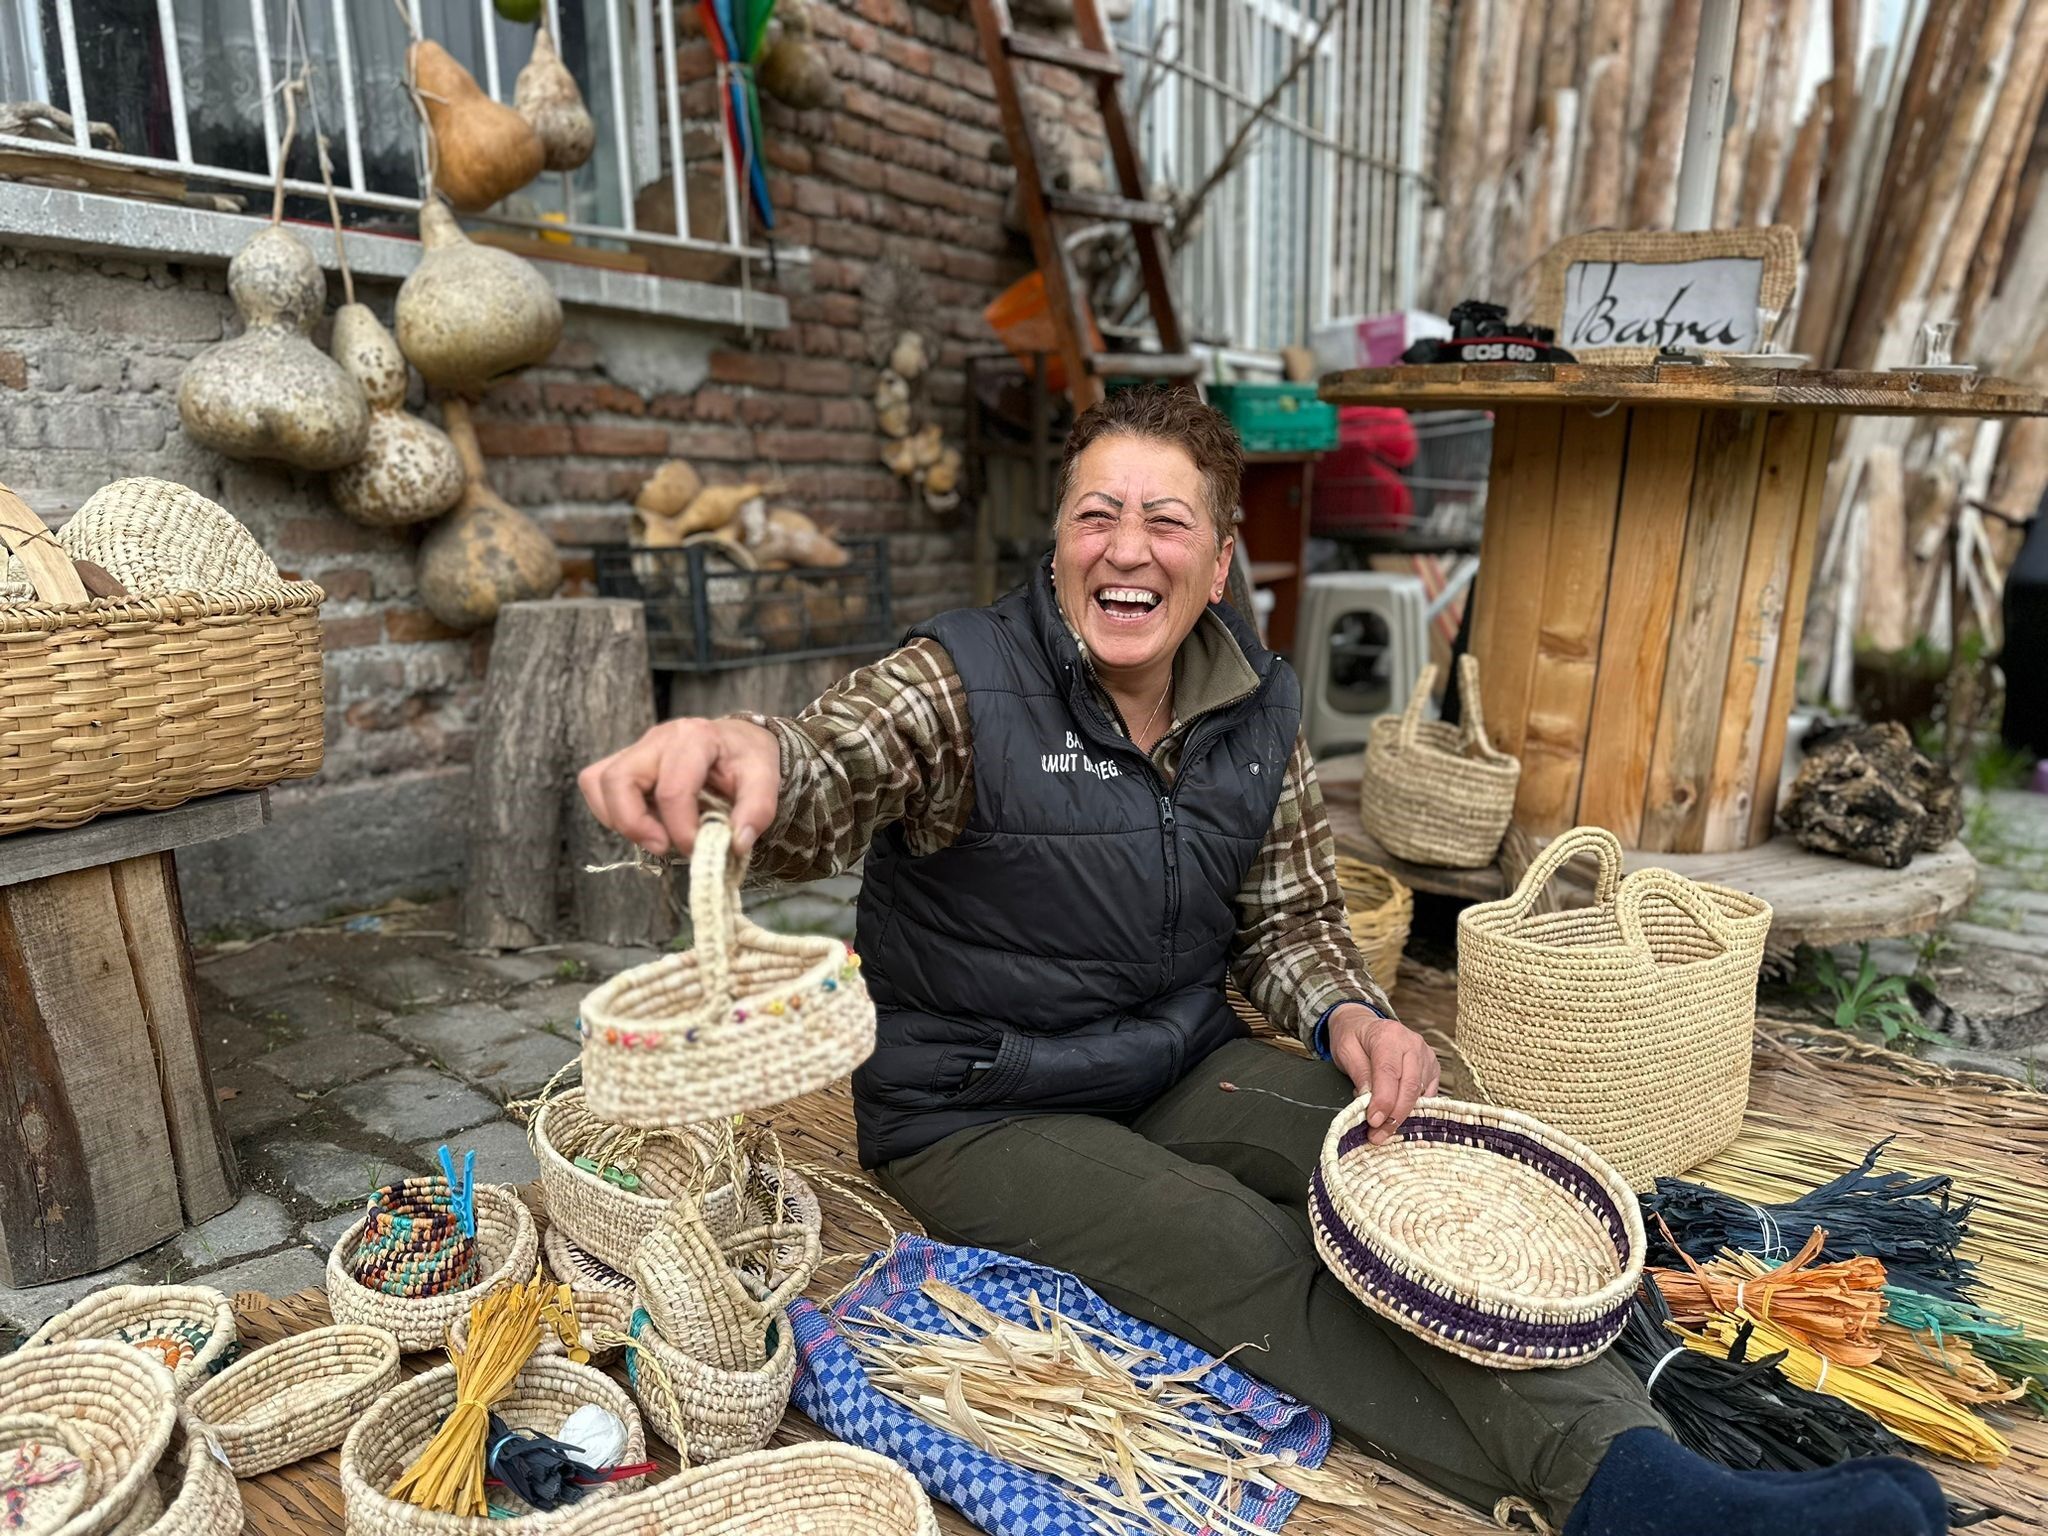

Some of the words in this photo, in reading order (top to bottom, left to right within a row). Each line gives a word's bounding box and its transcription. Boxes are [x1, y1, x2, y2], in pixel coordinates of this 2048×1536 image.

[1572, 262, 1744, 347] Bafra
[1461, 344, 1505, 361] EOS
[1506, 343, 1537, 362] 60D
